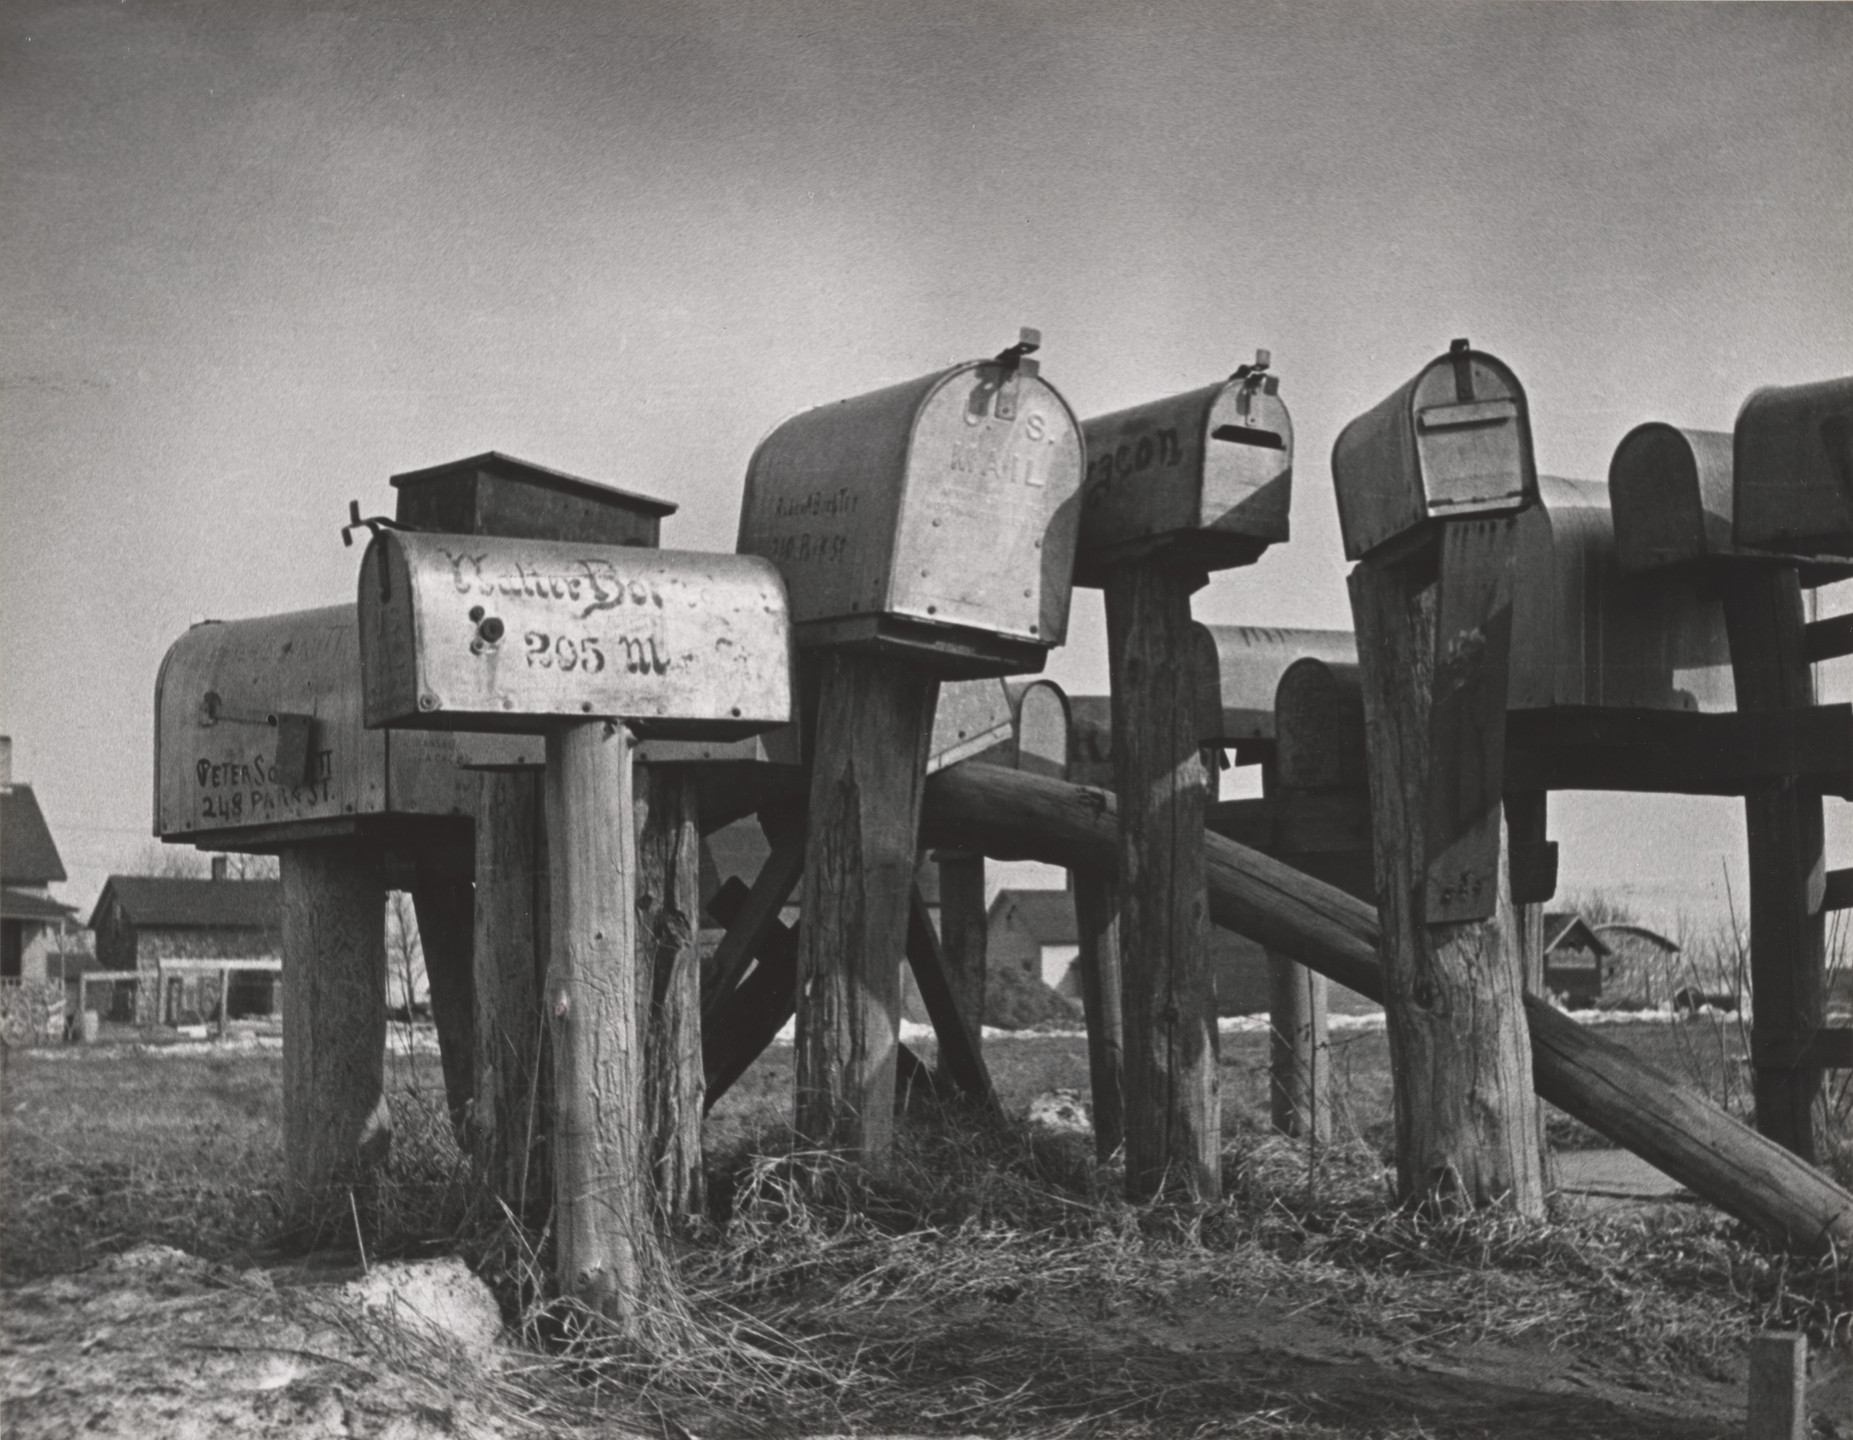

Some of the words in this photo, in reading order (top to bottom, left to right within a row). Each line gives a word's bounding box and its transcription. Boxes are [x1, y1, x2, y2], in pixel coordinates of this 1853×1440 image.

[950, 441, 1046, 488] MAIL
[524, 629, 606, 675] 205
[196, 757, 250, 788] PETER
[201, 791, 243, 823] 248
